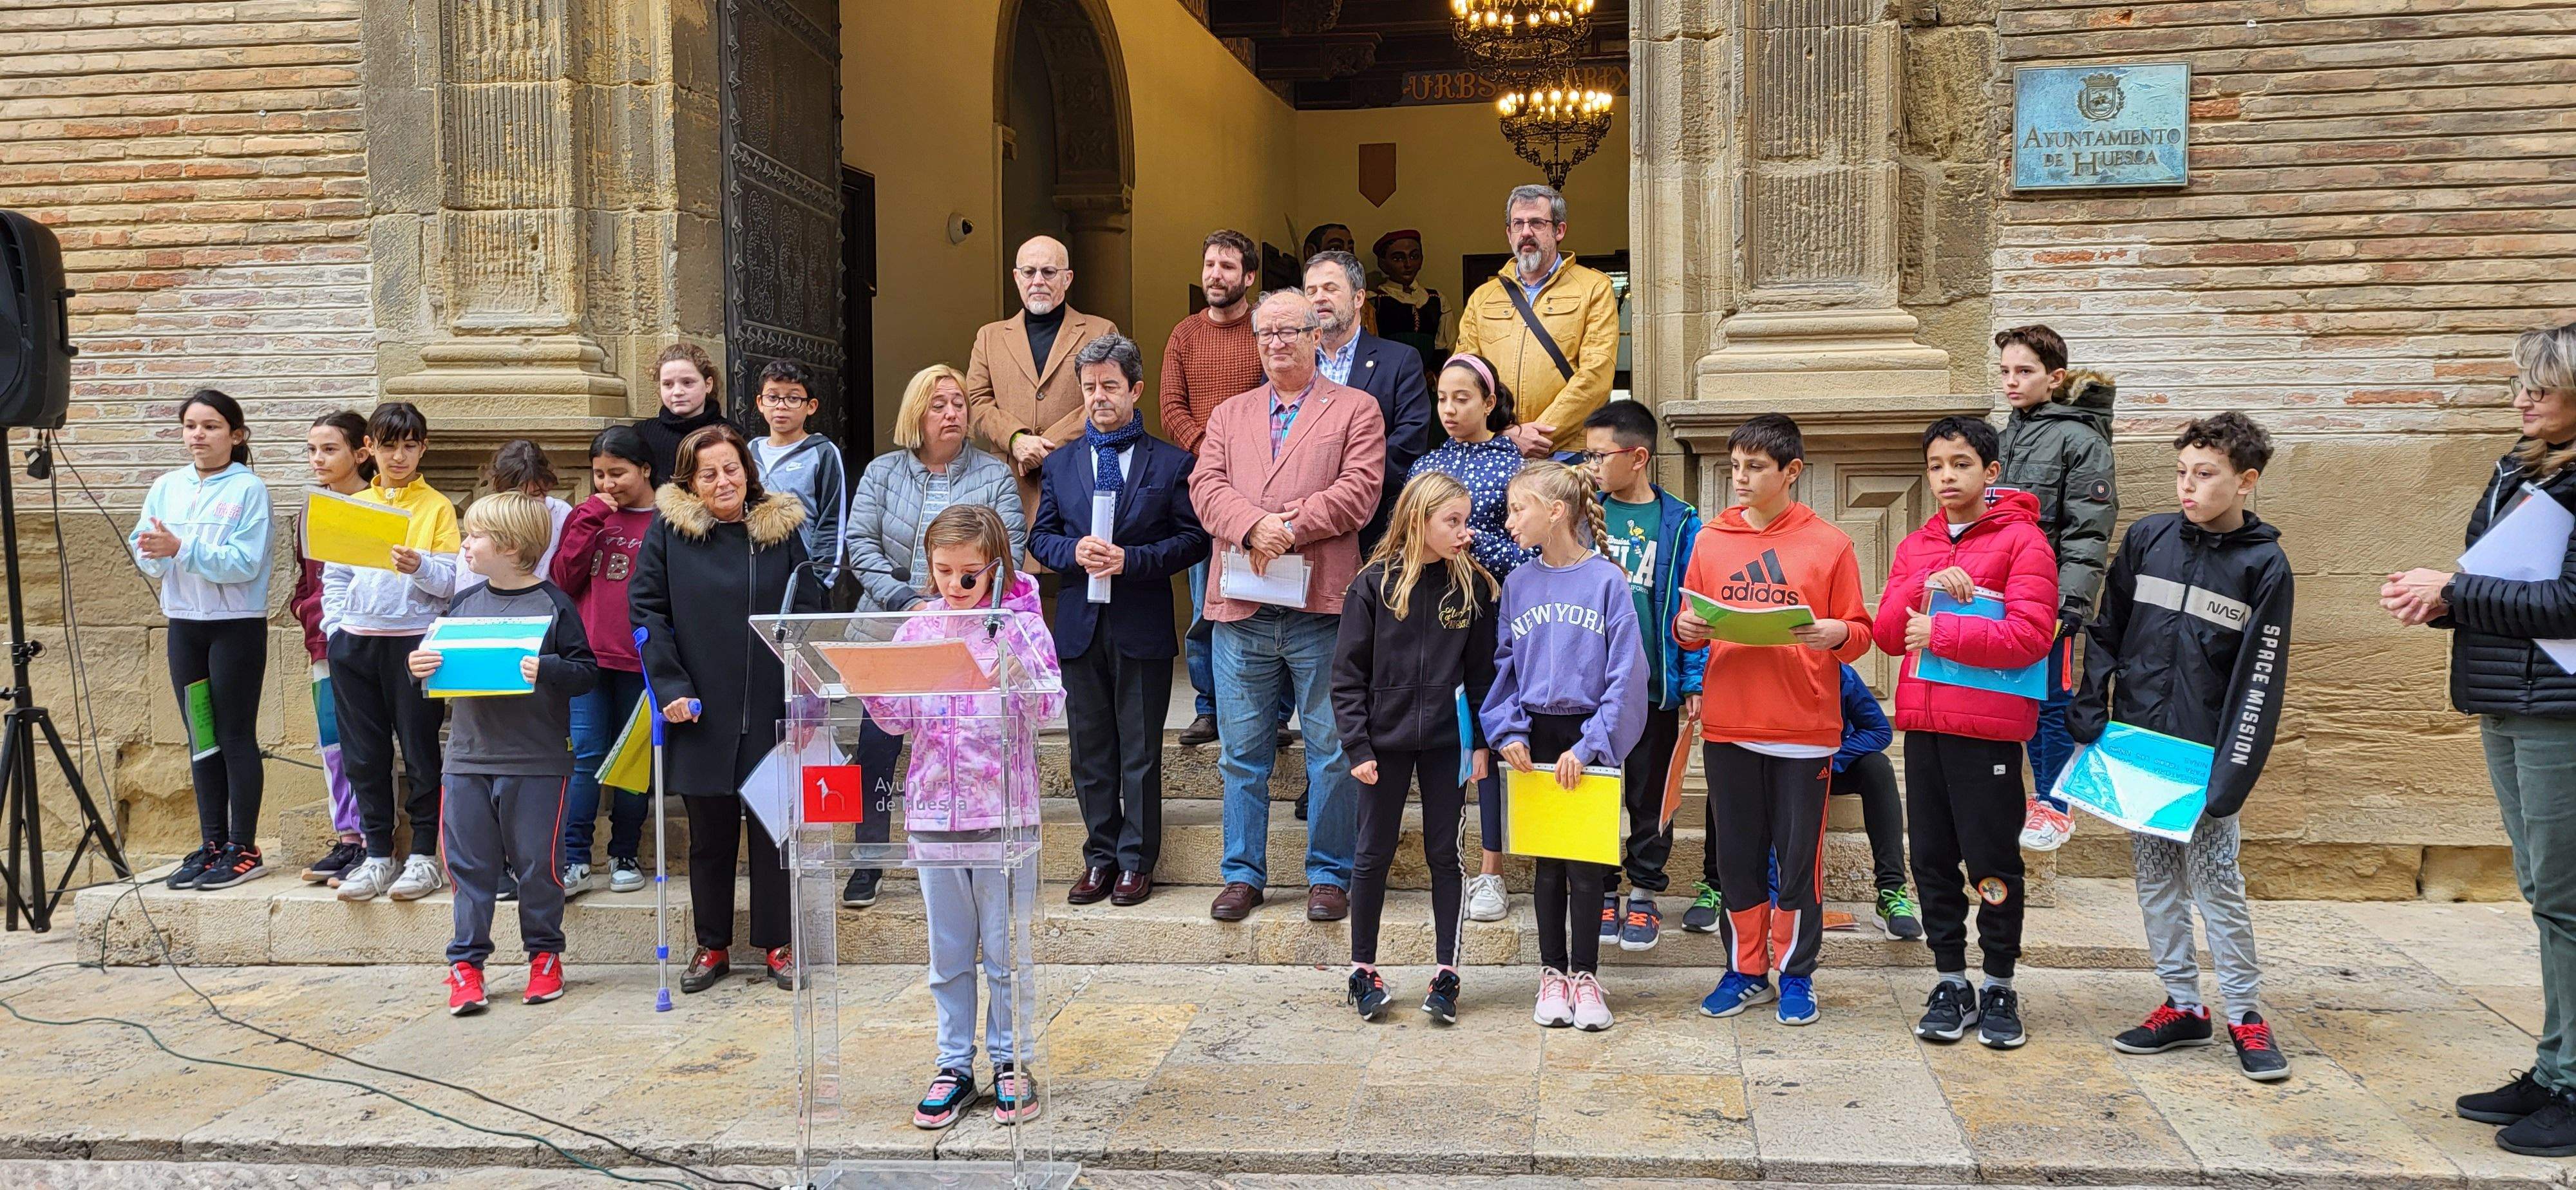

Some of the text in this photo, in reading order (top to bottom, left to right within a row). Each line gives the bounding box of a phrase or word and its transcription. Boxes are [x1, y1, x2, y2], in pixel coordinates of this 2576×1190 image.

[1409, 72, 1497, 99] URBS
[2023, 125, 2181, 149] AYUNTAMIENTO
[2043, 148, 2159, 177] DE HUESCA
[1721, 581, 1799, 606] adidas
[1511, 603, 1552, 641] NEW
[2206, 601, 2247, 622] NASA
[2230, 624, 2282, 766] SPACE MISSION
[875, 777, 996, 797] Ayuntamnto
[876, 796, 896, 812] de
